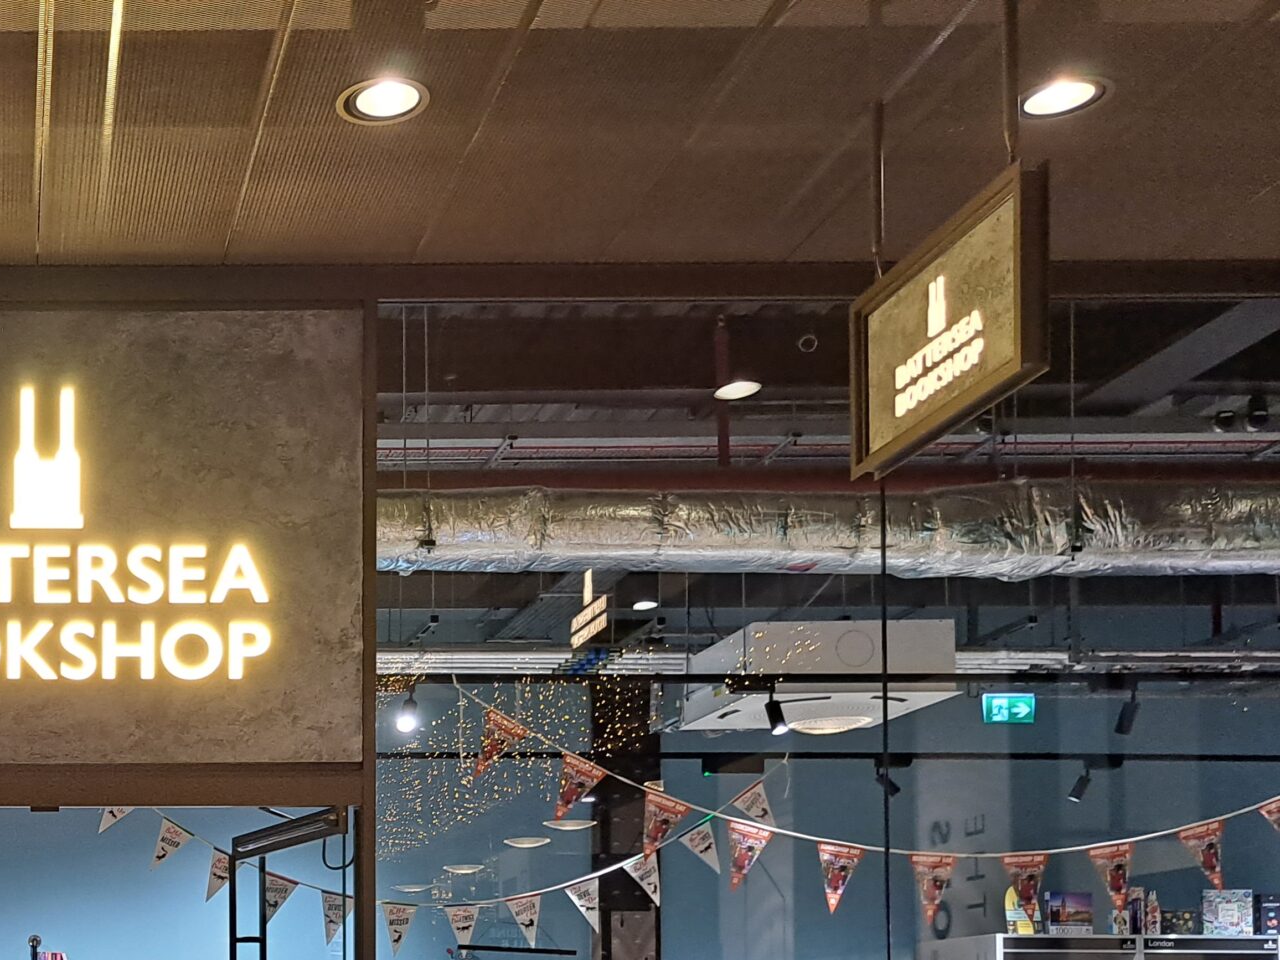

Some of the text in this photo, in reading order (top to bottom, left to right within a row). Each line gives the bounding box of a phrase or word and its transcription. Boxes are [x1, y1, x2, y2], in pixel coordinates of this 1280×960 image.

[894, 337, 984, 417] BOOKSHOP
[895, 310, 983, 389] BATTERSEA
[389, 918, 409, 926] MISSED
